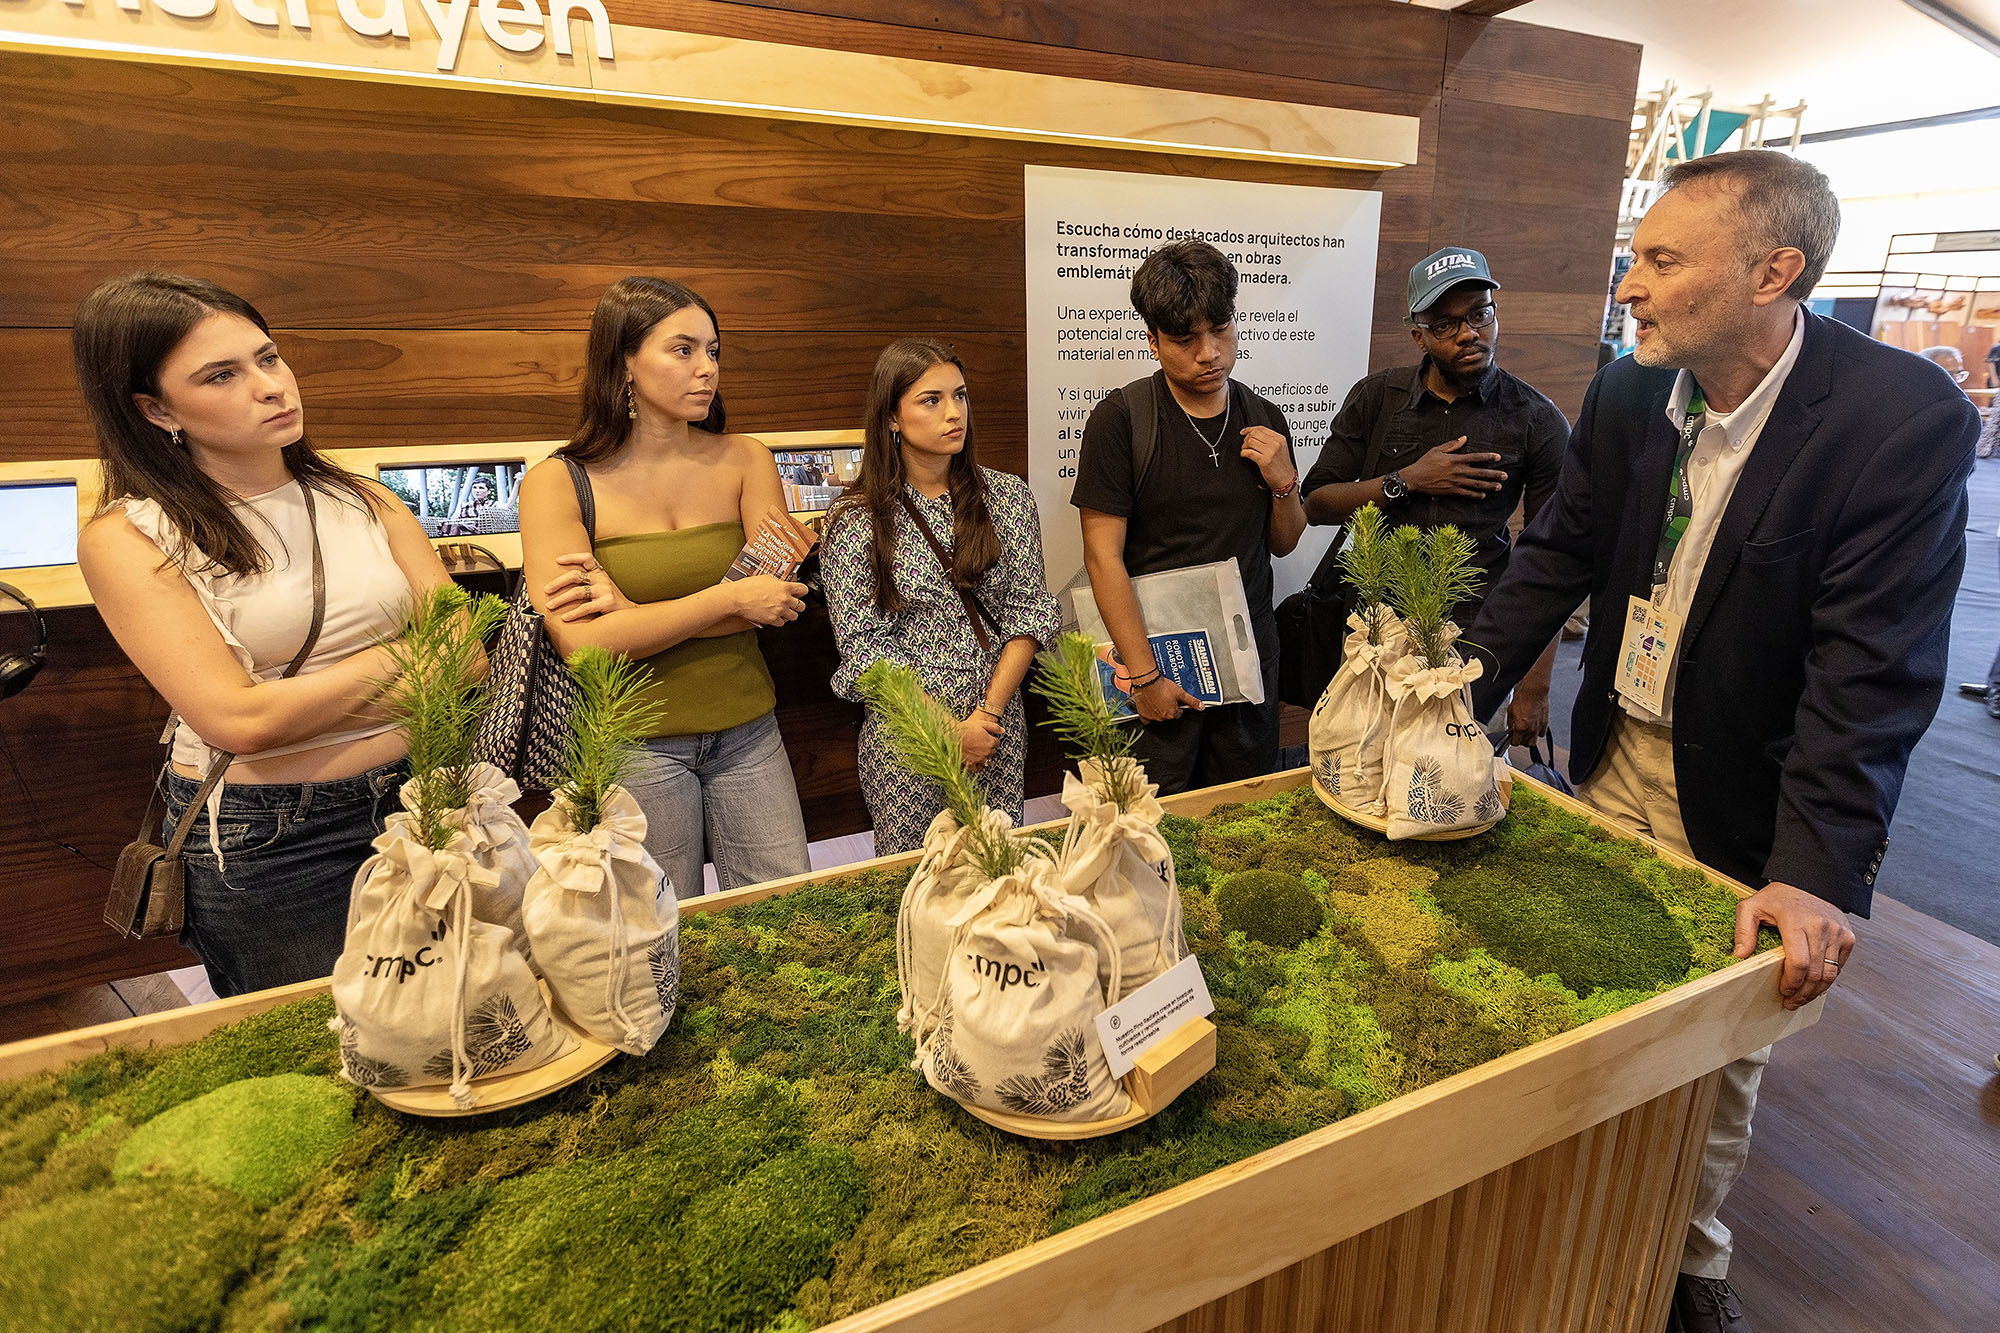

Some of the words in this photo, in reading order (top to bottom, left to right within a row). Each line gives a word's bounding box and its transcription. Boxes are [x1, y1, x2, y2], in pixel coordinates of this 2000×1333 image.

[1056, 220, 1120, 238] Escucha
[1123, 223, 1162, 240] cómo
[1165, 226, 1244, 244] destacados
[1247, 232, 1320, 249] arquitectos
[1322, 235, 1345, 249] han
[1227, 252, 1242, 264] en
[1245, 251, 1282, 265] obras
[1424, 253, 1476, 276] TOTAL
[1056, 264, 1136, 280] emblemáti
[1240, 271, 1292, 285] madera.
[1057, 305, 1086, 320] Una
[1249, 309, 1286, 323] revela
[1287, 309, 1299, 323] el
[1057, 326, 1122, 344] potencial
[1125, 329, 1148, 341] cre
[1272, 328, 1288, 341] de
[1289, 329, 1316, 341] este
[1057, 347, 1115, 361] material
[1117, 349, 1134, 361] en
[1137, 349, 1155, 361] ma
[1236, 349, 1253, 360] as.
[1057, 387, 1067, 401] Y
[1069, 387, 1080, 401] si
[1083, 386, 1112, 404] quie
[1252, 382, 1312, 396] beneficios
[1314, 382, 1329, 395] de
[1057, 406, 1087, 421] vivir
[1297, 403, 1305, 412] a
[1306, 399, 1337, 412] subir
[1057, 426, 1071, 440] al
[1682, 415, 1695, 440] cmpc
[1057, 447, 1076, 460] un
[1057, 465, 1076, 479] de
[1682, 476, 1690, 501] cmpc
[757, 535, 766, 543] se
[766, 541, 787, 557] siente
[760, 528, 770, 538] La
[769, 535, 795, 554] madera
[749, 547, 758, 555] el
[757, 551, 778, 568] futuro
[753, 541, 787, 565] construye
[1164, 640, 1182, 687] COLABORATIV
[1171, 639, 1185, 670] ROBOTS
